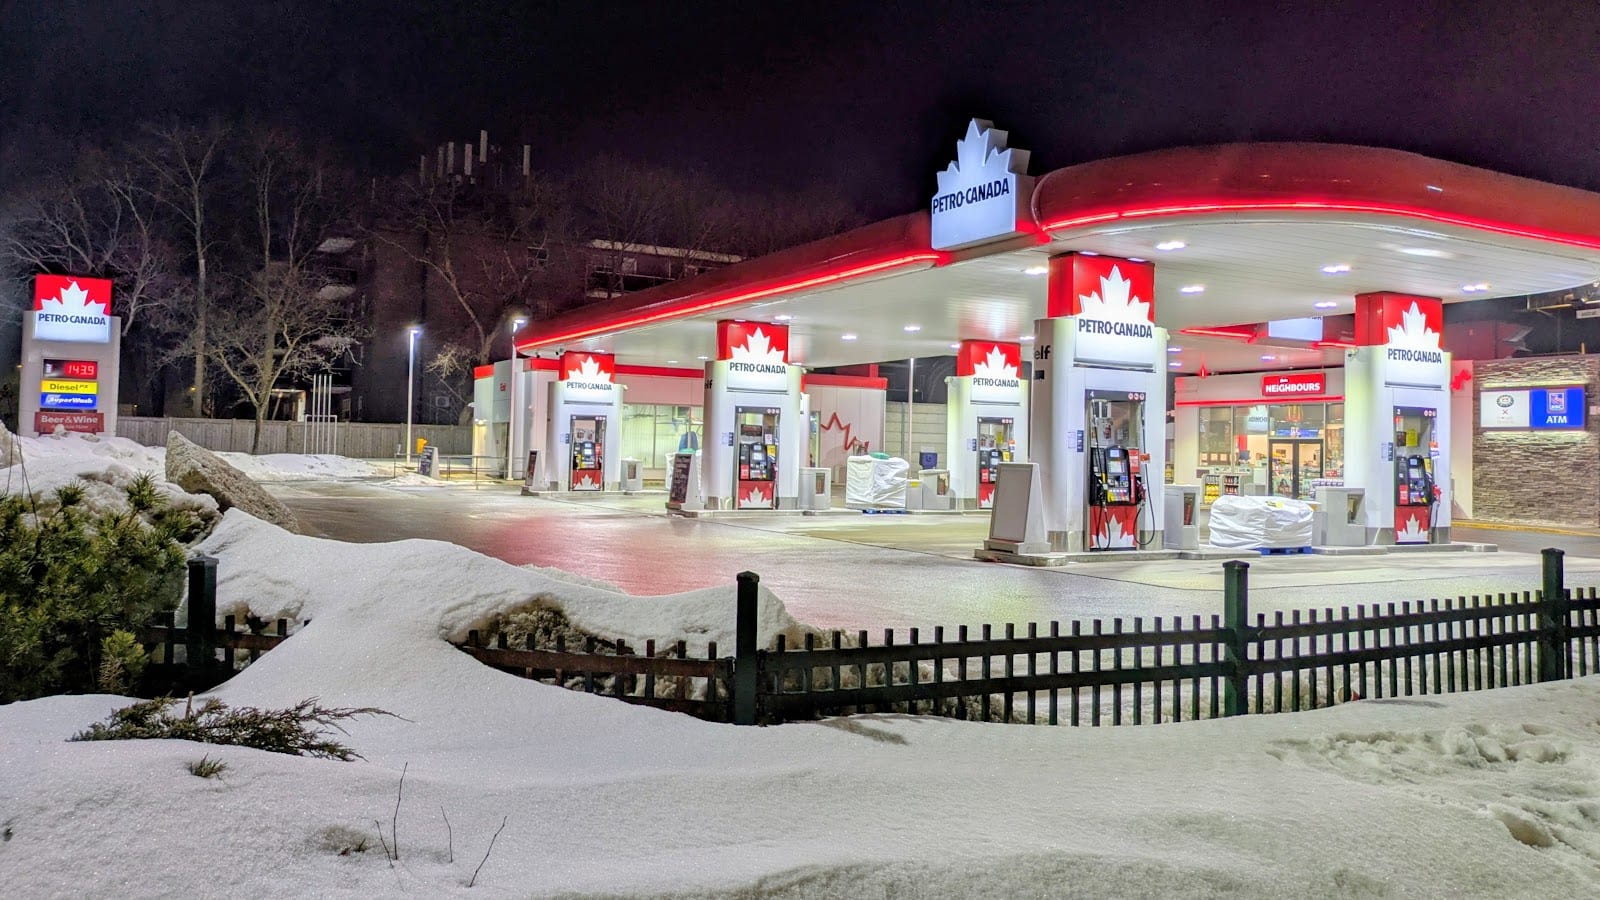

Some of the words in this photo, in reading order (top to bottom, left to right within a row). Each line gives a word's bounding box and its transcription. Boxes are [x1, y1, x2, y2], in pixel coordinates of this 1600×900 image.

[932, 179, 1010, 214] PETRO-CANADA
[38, 313, 106, 326] PETRO-CANADA
[1078, 319, 1153, 339] PETRO-CANADA
[1387, 347, 1442, 364] PETRO-CANADA
[729, 361, 787, 375] PETRO-CANADA
[50, 383, 78, 391] Diesel
[566, 381, 612, 391] PETRO-CANADA
[972, 377, 1019, 388] PETRO-CANADA
[1265, 383, 1320, 393] NEIGHBOURS
[1546, 416, 1567, 424] ATM
